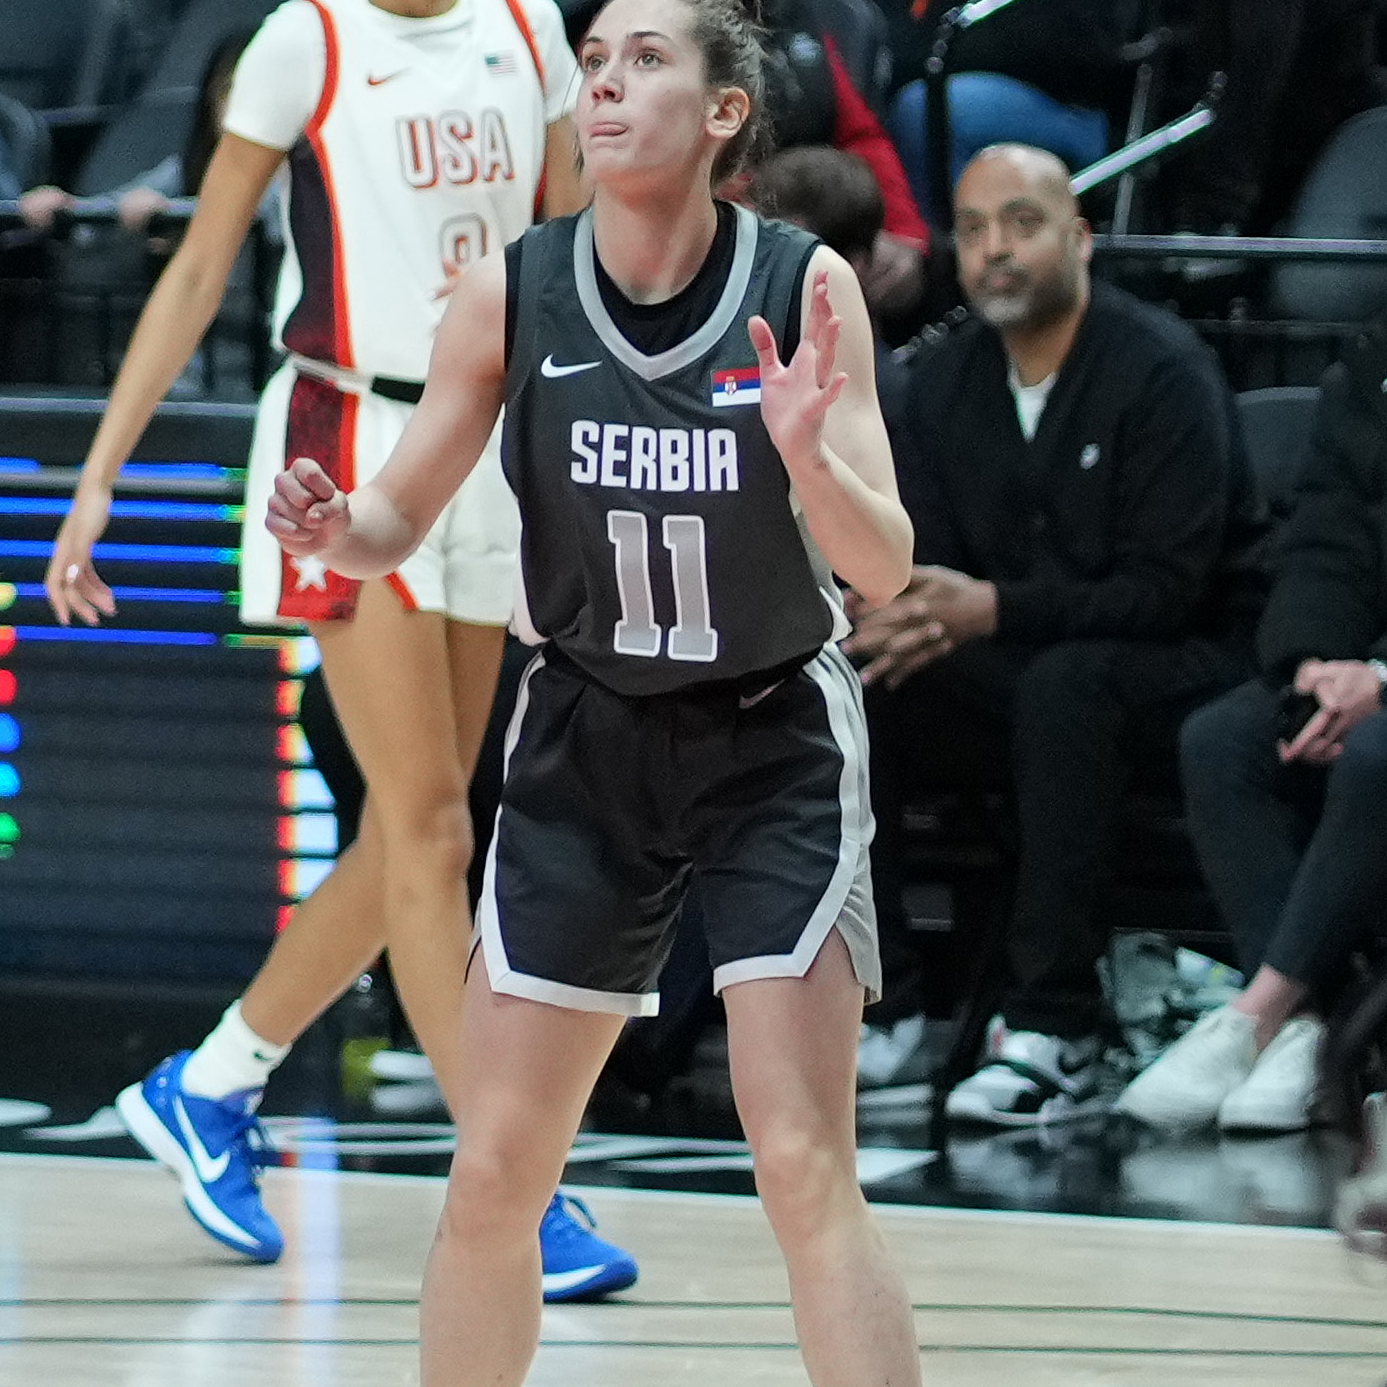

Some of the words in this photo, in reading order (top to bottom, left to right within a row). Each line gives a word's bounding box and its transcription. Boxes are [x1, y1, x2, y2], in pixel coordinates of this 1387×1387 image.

[394, 107, 515, 189] USA
[570, 419, 740, 492] SERBIA
[607, 510, 718, 662] 11
